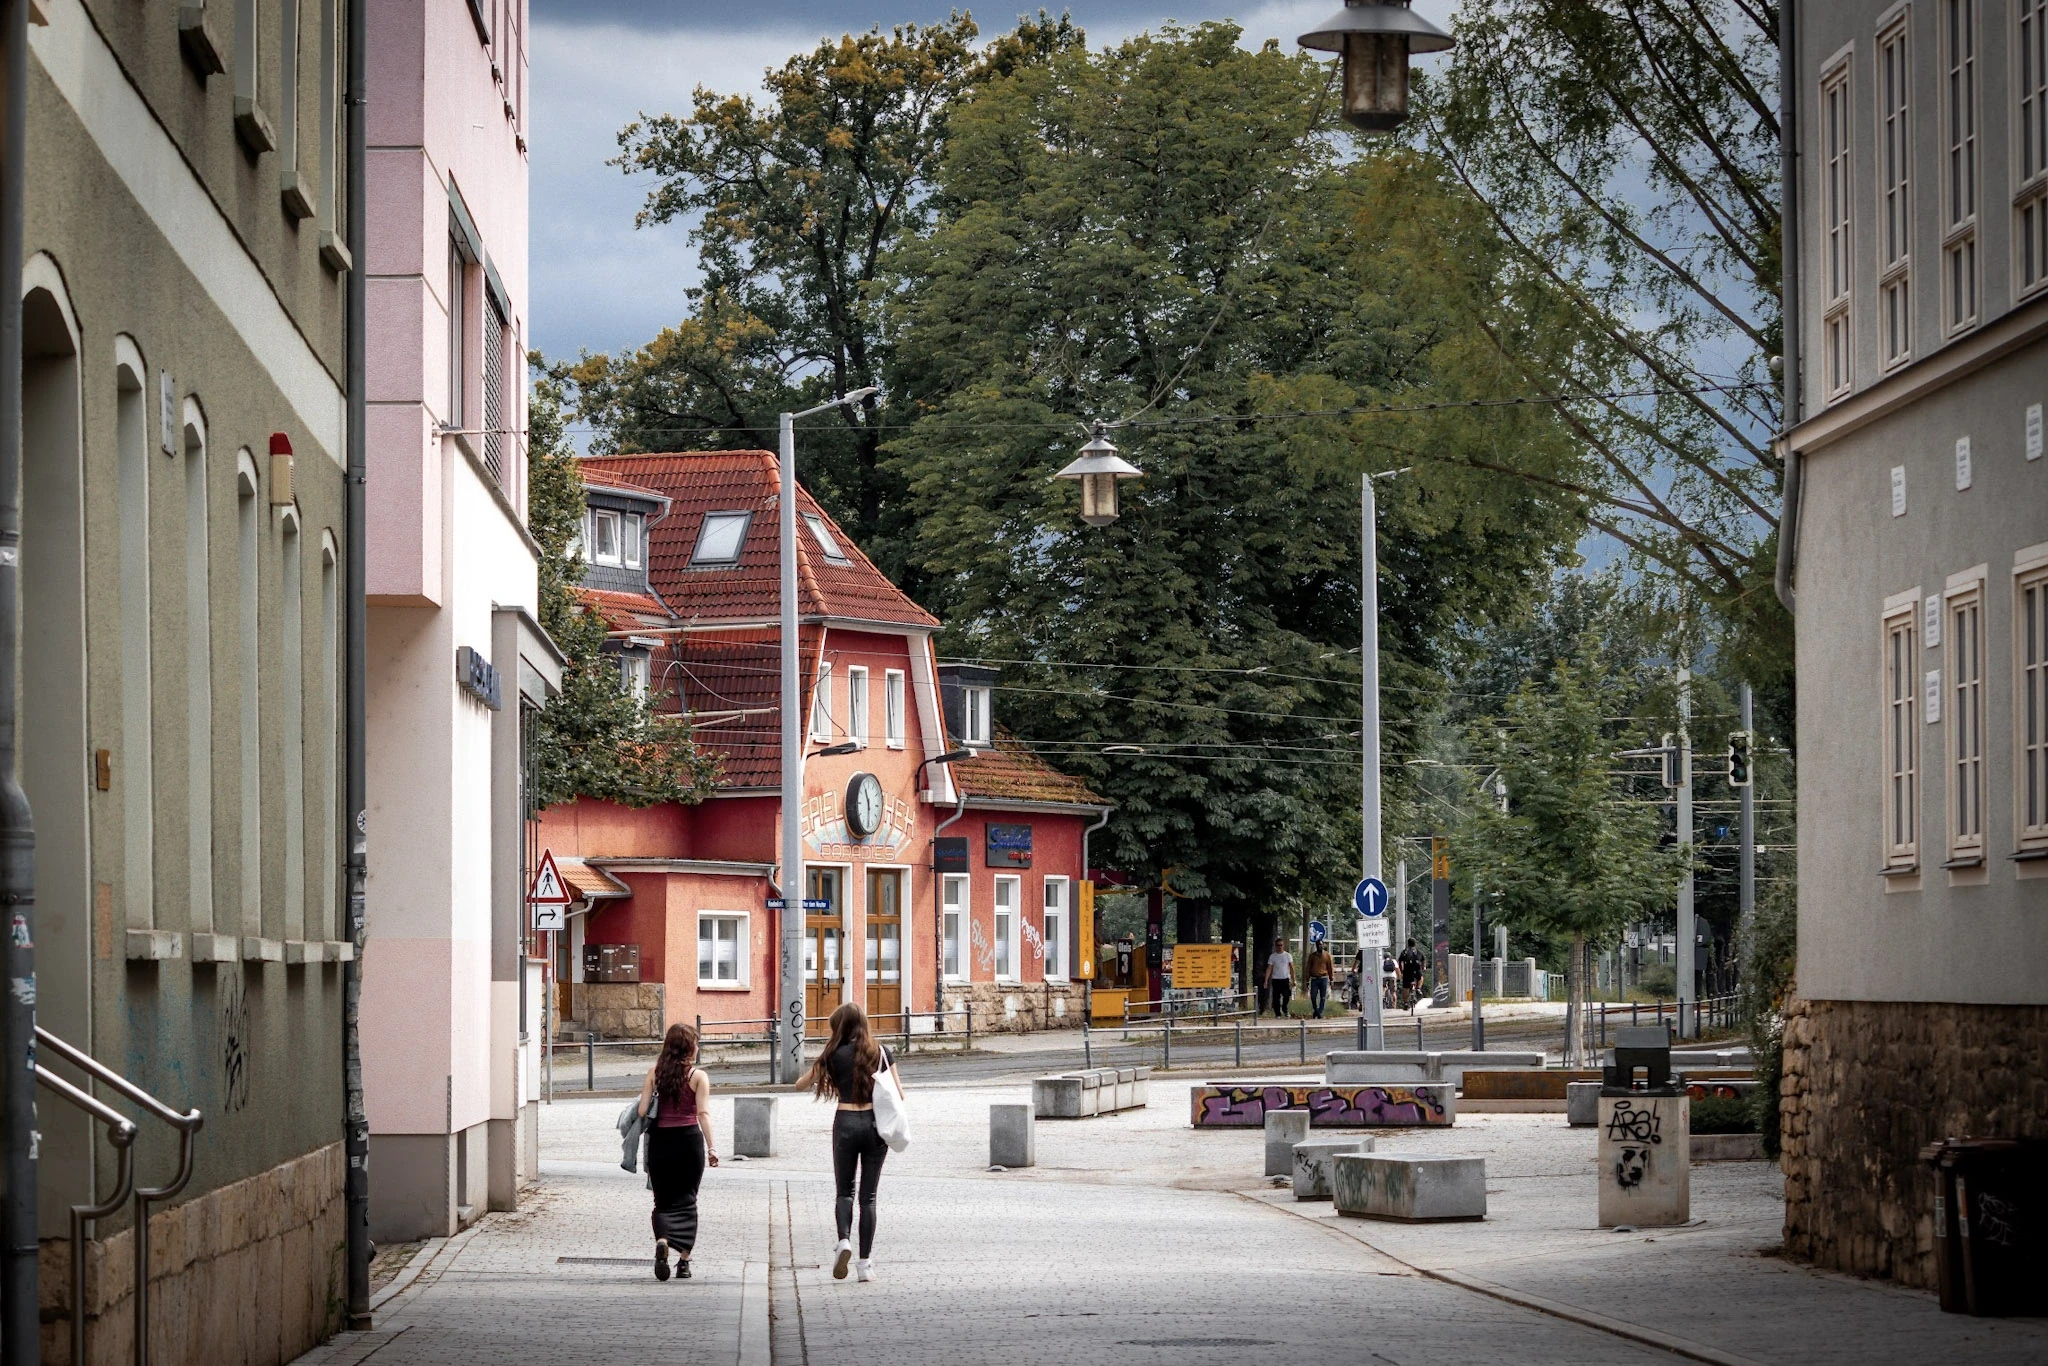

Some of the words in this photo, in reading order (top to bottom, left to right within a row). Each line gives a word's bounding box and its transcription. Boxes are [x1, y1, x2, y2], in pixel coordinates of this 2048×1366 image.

[821, 843, 895, 861] PARADIES
[1118, 942, 1132, 953] Gleis
[1631, 939, 1636, 947] 6
[1121, 953, 1129, 974] 3
